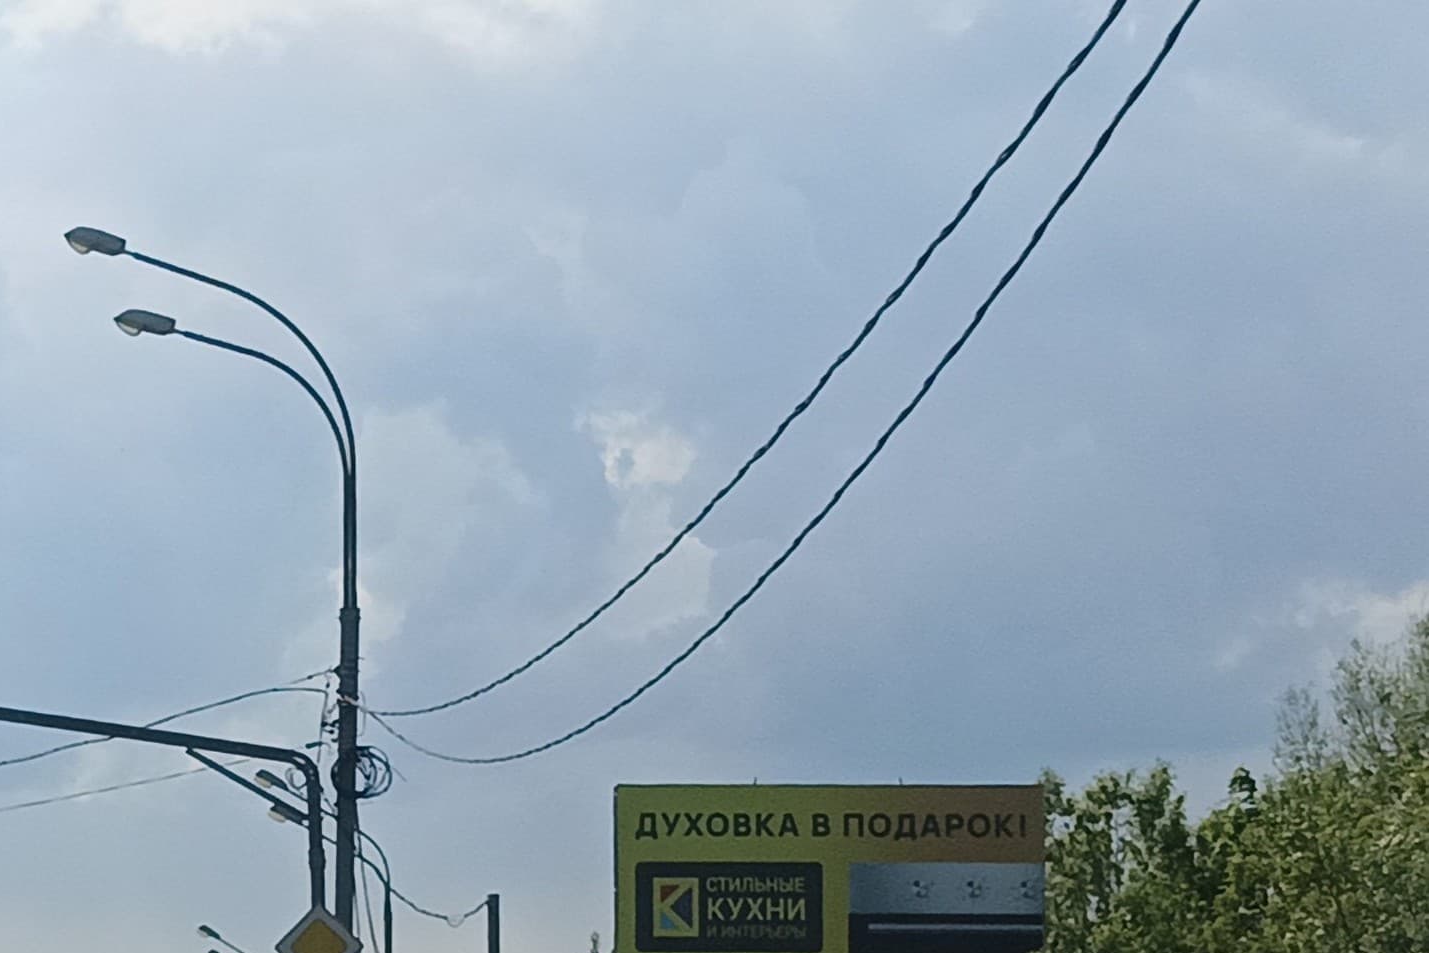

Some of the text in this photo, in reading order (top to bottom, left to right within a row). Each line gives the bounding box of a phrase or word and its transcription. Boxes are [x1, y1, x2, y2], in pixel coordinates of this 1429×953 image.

[635, 812, 1027, 841] ДУХОВКА В ПОДАРОК!
[705, 876, 806, 893] СТИЛЬНЫЕ
[706, 897, 806, 921] КУХНИ
